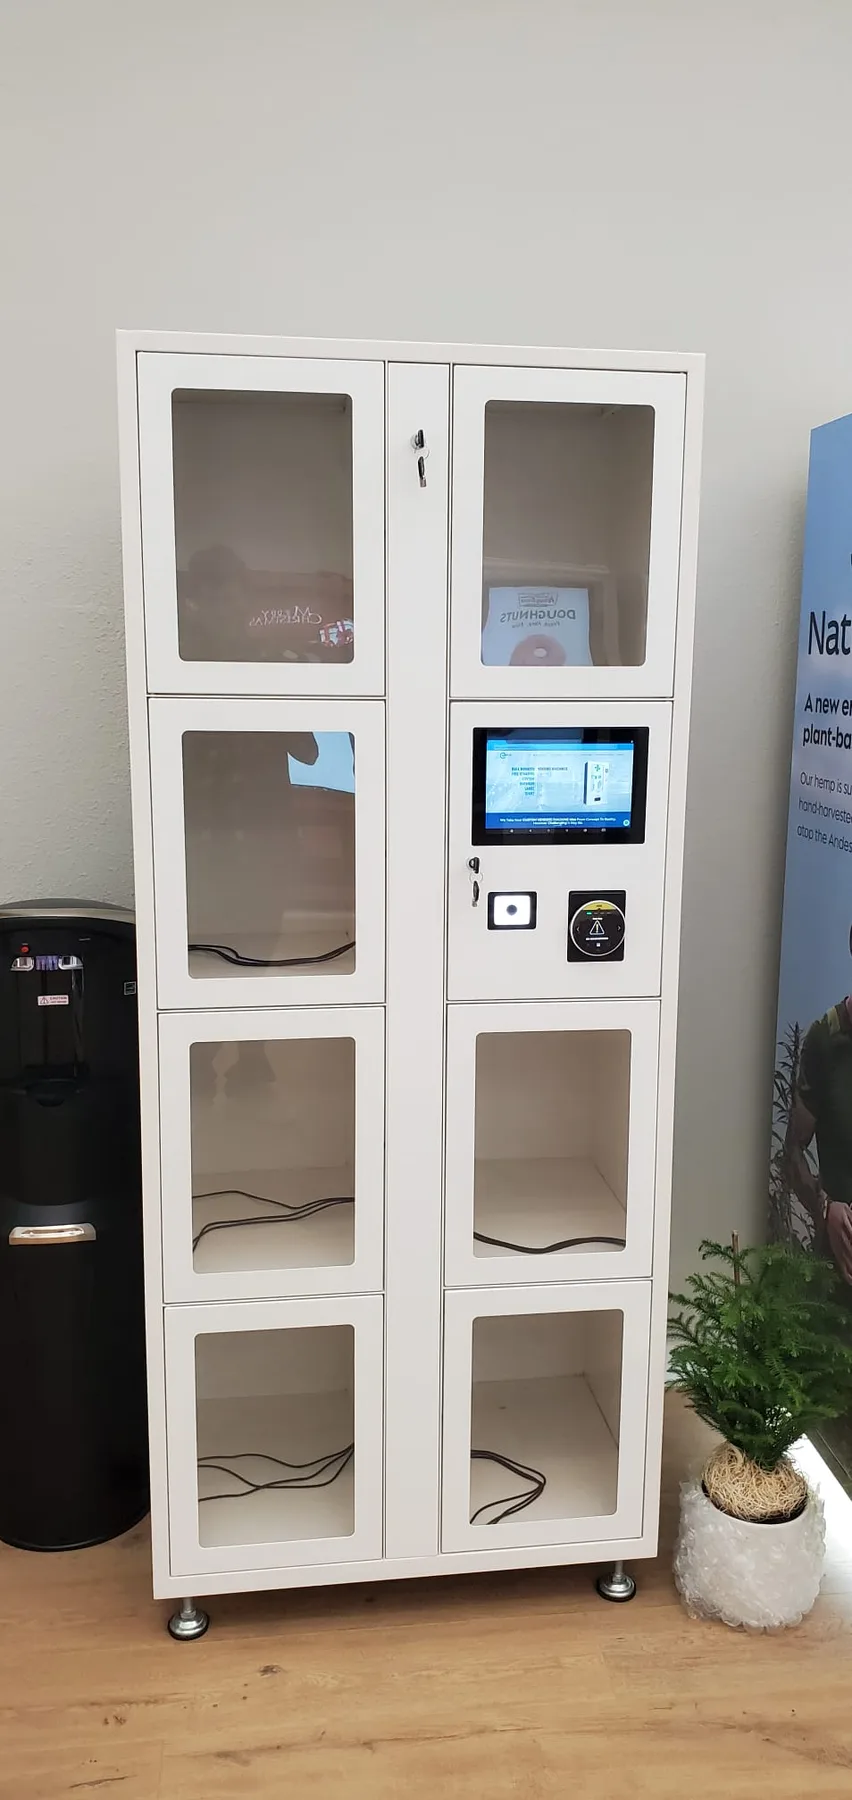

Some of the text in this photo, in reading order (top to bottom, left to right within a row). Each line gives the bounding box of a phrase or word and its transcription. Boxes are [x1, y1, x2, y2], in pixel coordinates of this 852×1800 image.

[808, 610, 852, 656] Nat
[804, 692, 813, 713] A
[815, 697, 840, 715] new
[802, 723, 852, 750] plant-ba
[800, 771, 813, 787] Our
[814, 774, 836, 793] hemp
[836, 778, 843, 794] is
[798, 796, 852, 824] hand-harveste
[797, 825, 814, 841] atop
[815, 829, 828, 844] the
